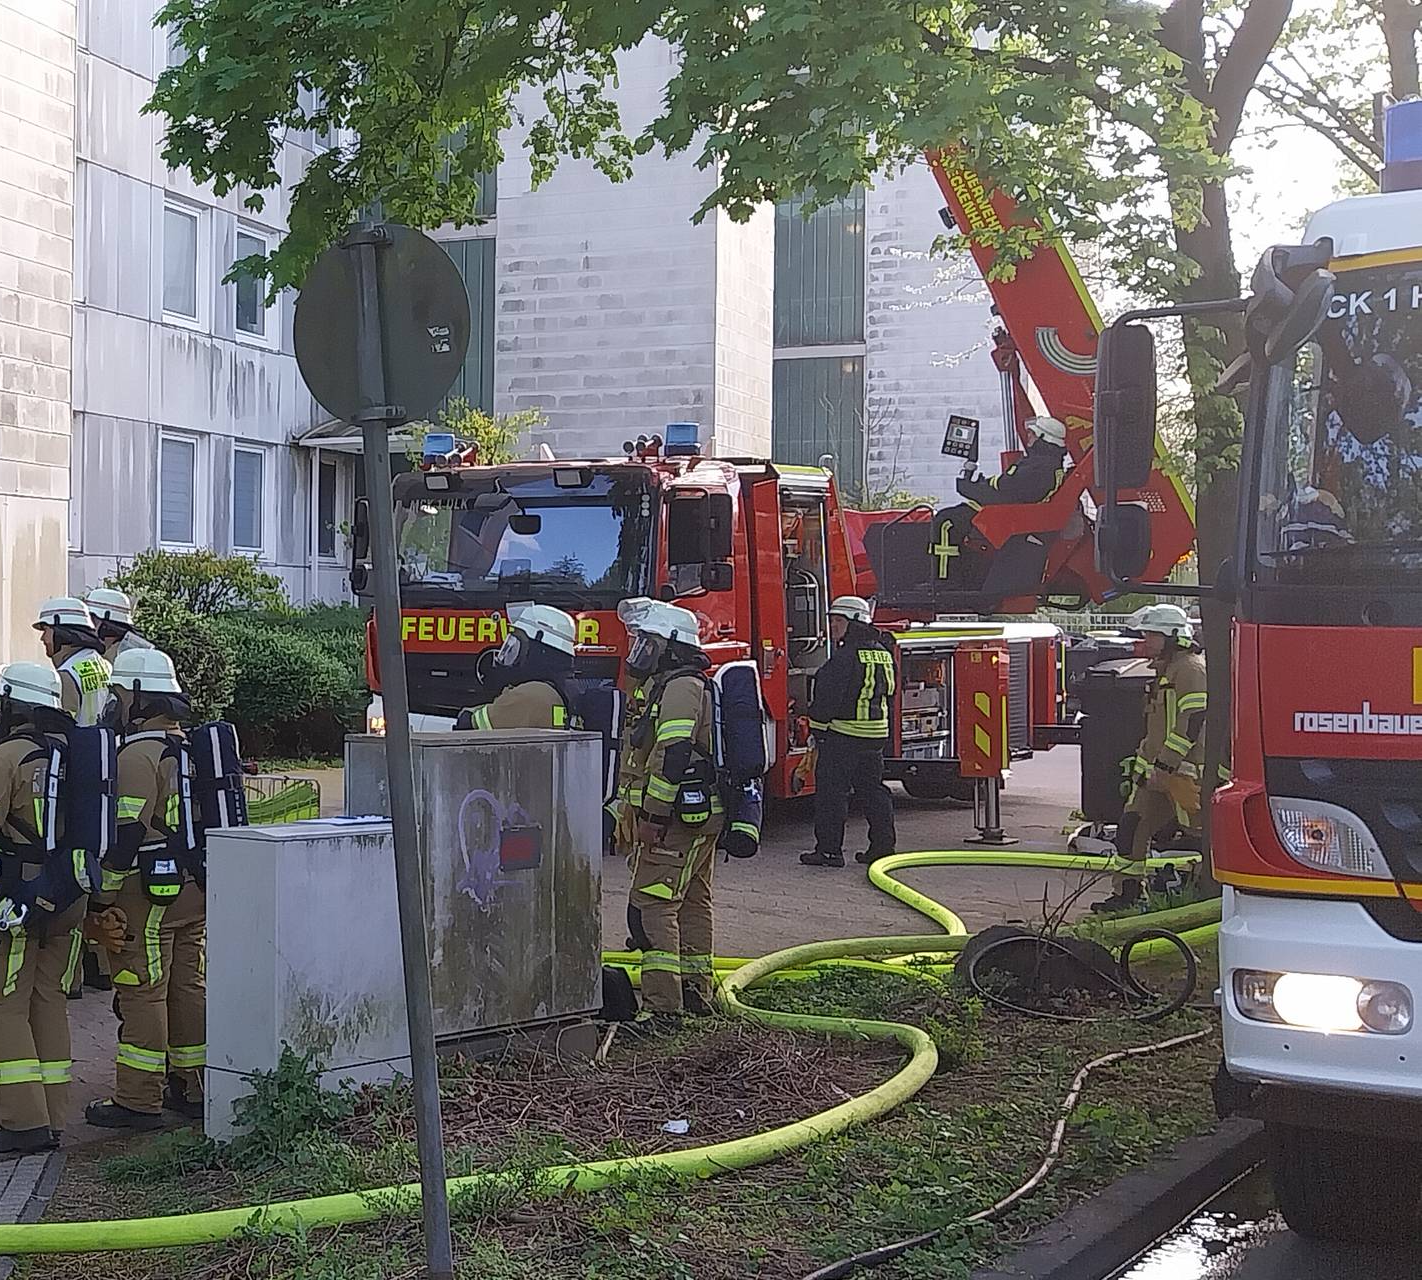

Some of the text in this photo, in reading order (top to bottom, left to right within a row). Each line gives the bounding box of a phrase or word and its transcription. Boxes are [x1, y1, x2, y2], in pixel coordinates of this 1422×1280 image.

[1326, 290, 1373, 319] CK
[1383, 287, 1397, 311] 1
[401, 616, 600, 645] FEUERR
